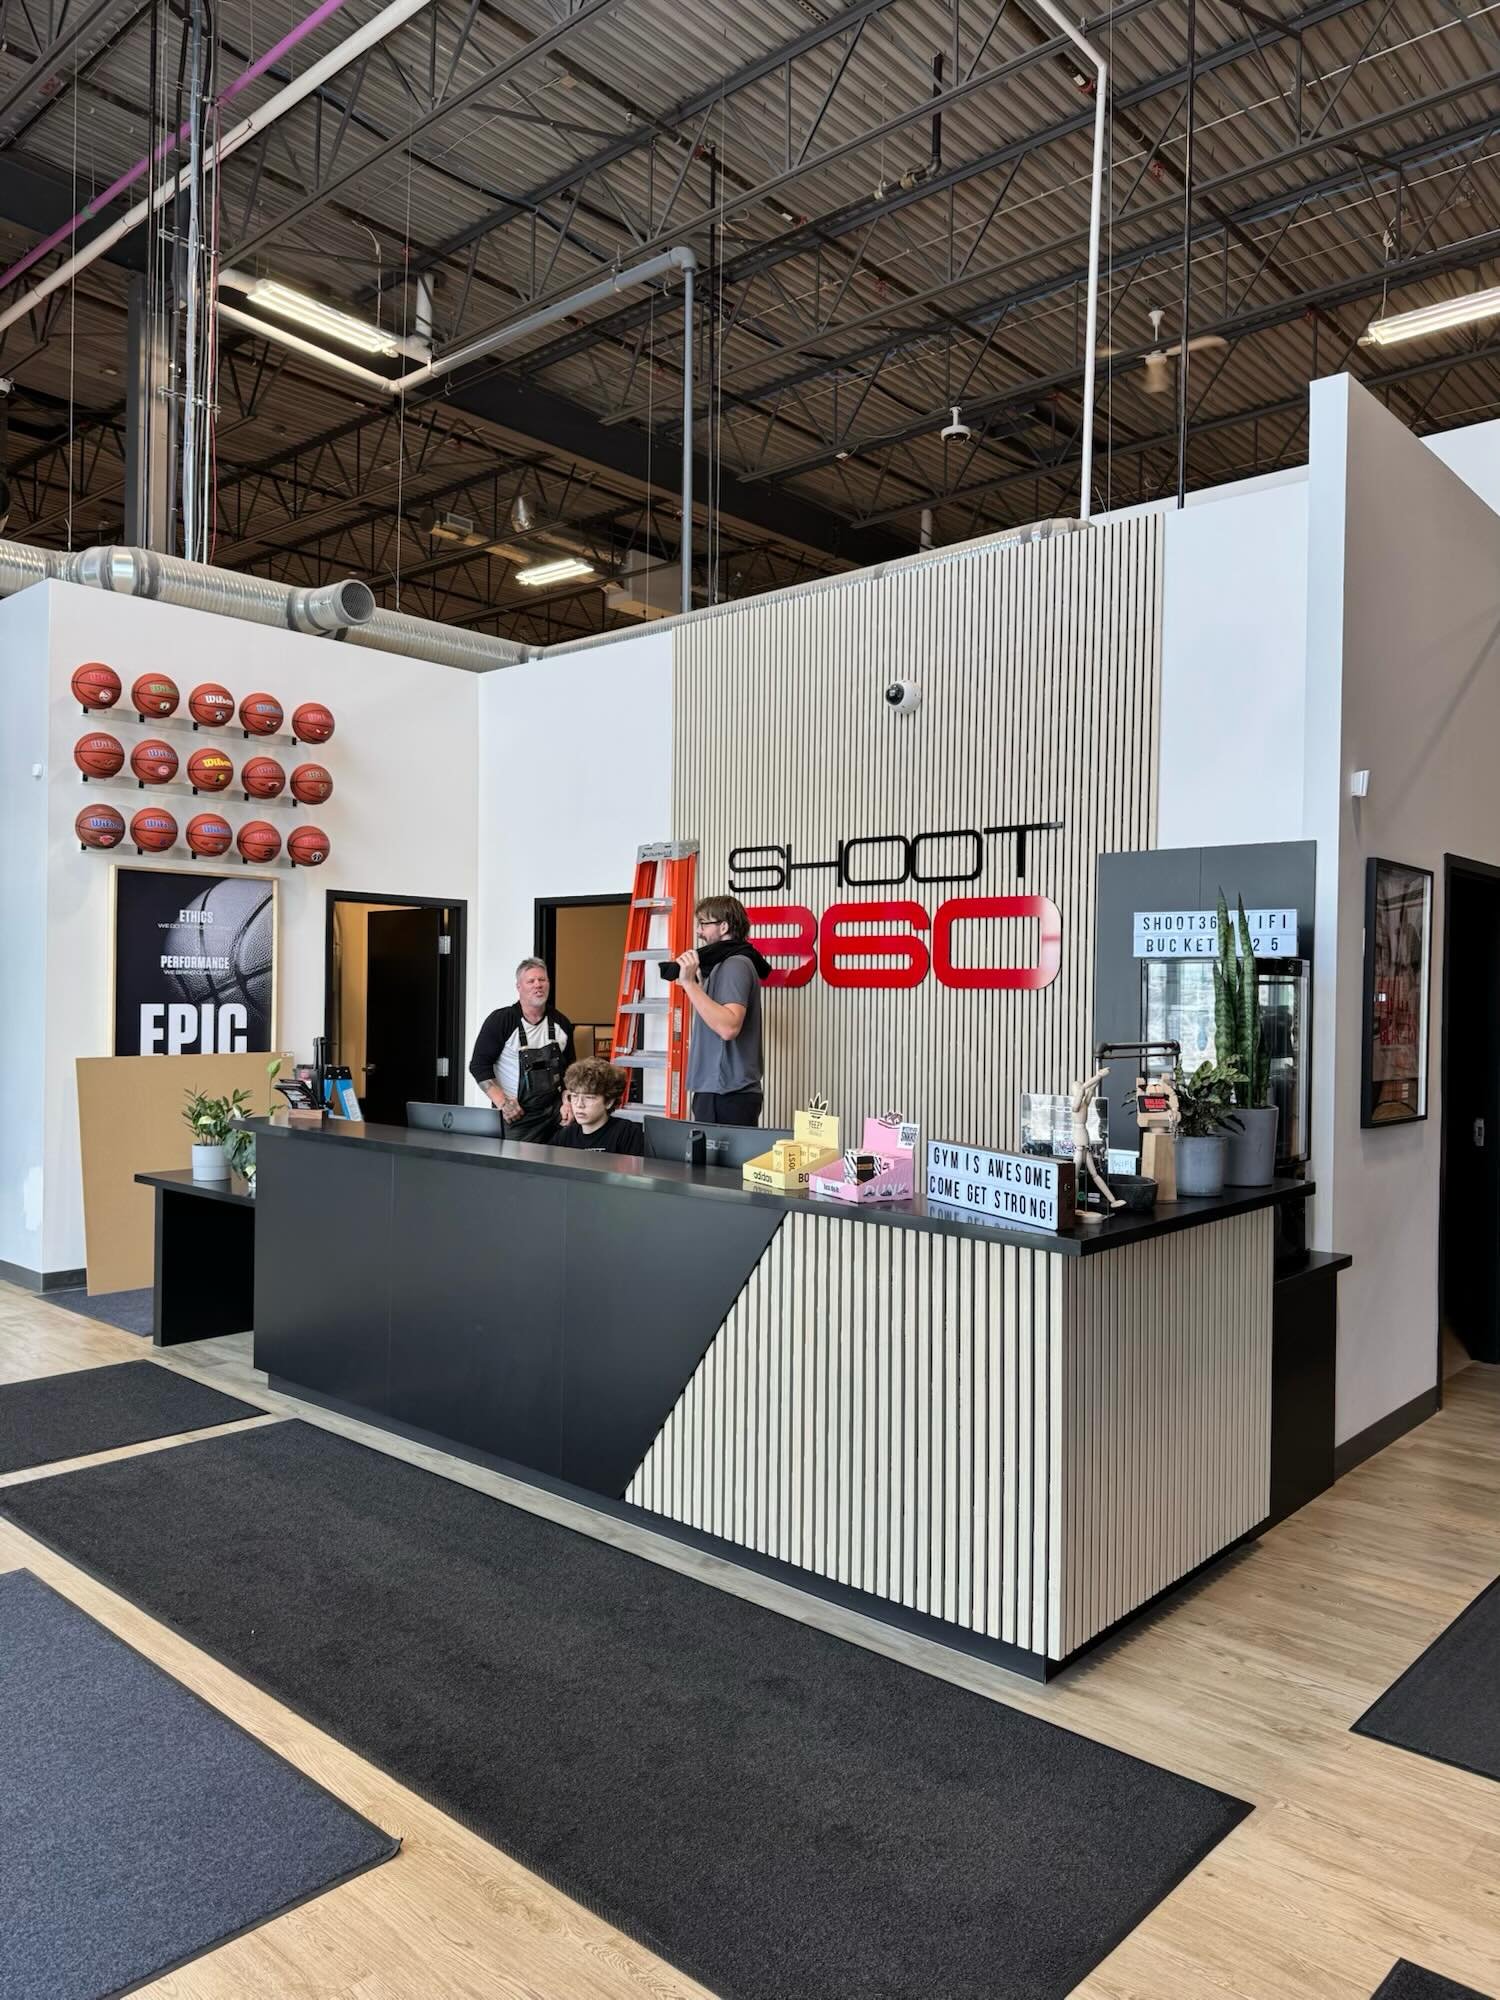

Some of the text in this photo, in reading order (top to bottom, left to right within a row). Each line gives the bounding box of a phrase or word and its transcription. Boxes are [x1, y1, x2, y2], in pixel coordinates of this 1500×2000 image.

[729, 821, 1063, 892] SHOOT
[179, 910, 214, 923] ETHICS
[1143, 914, 1286, 930] SHOOT36 IFI
[1146, 938, 1214, 952] BUCKET
[160, 955, 230, 969] PERFORMANCE
[140, 1003, 247, 1056] EPIC
[706, 1139, 730, 1151] SUS
[934, 1146, 1051, 1189] GYM IS AWESOME
[753, 1171, 772, 1184] adidas
[798, 1173, 810, 1183] BO
[929, 1176, 1053, 1221] COME GET STRONG!
